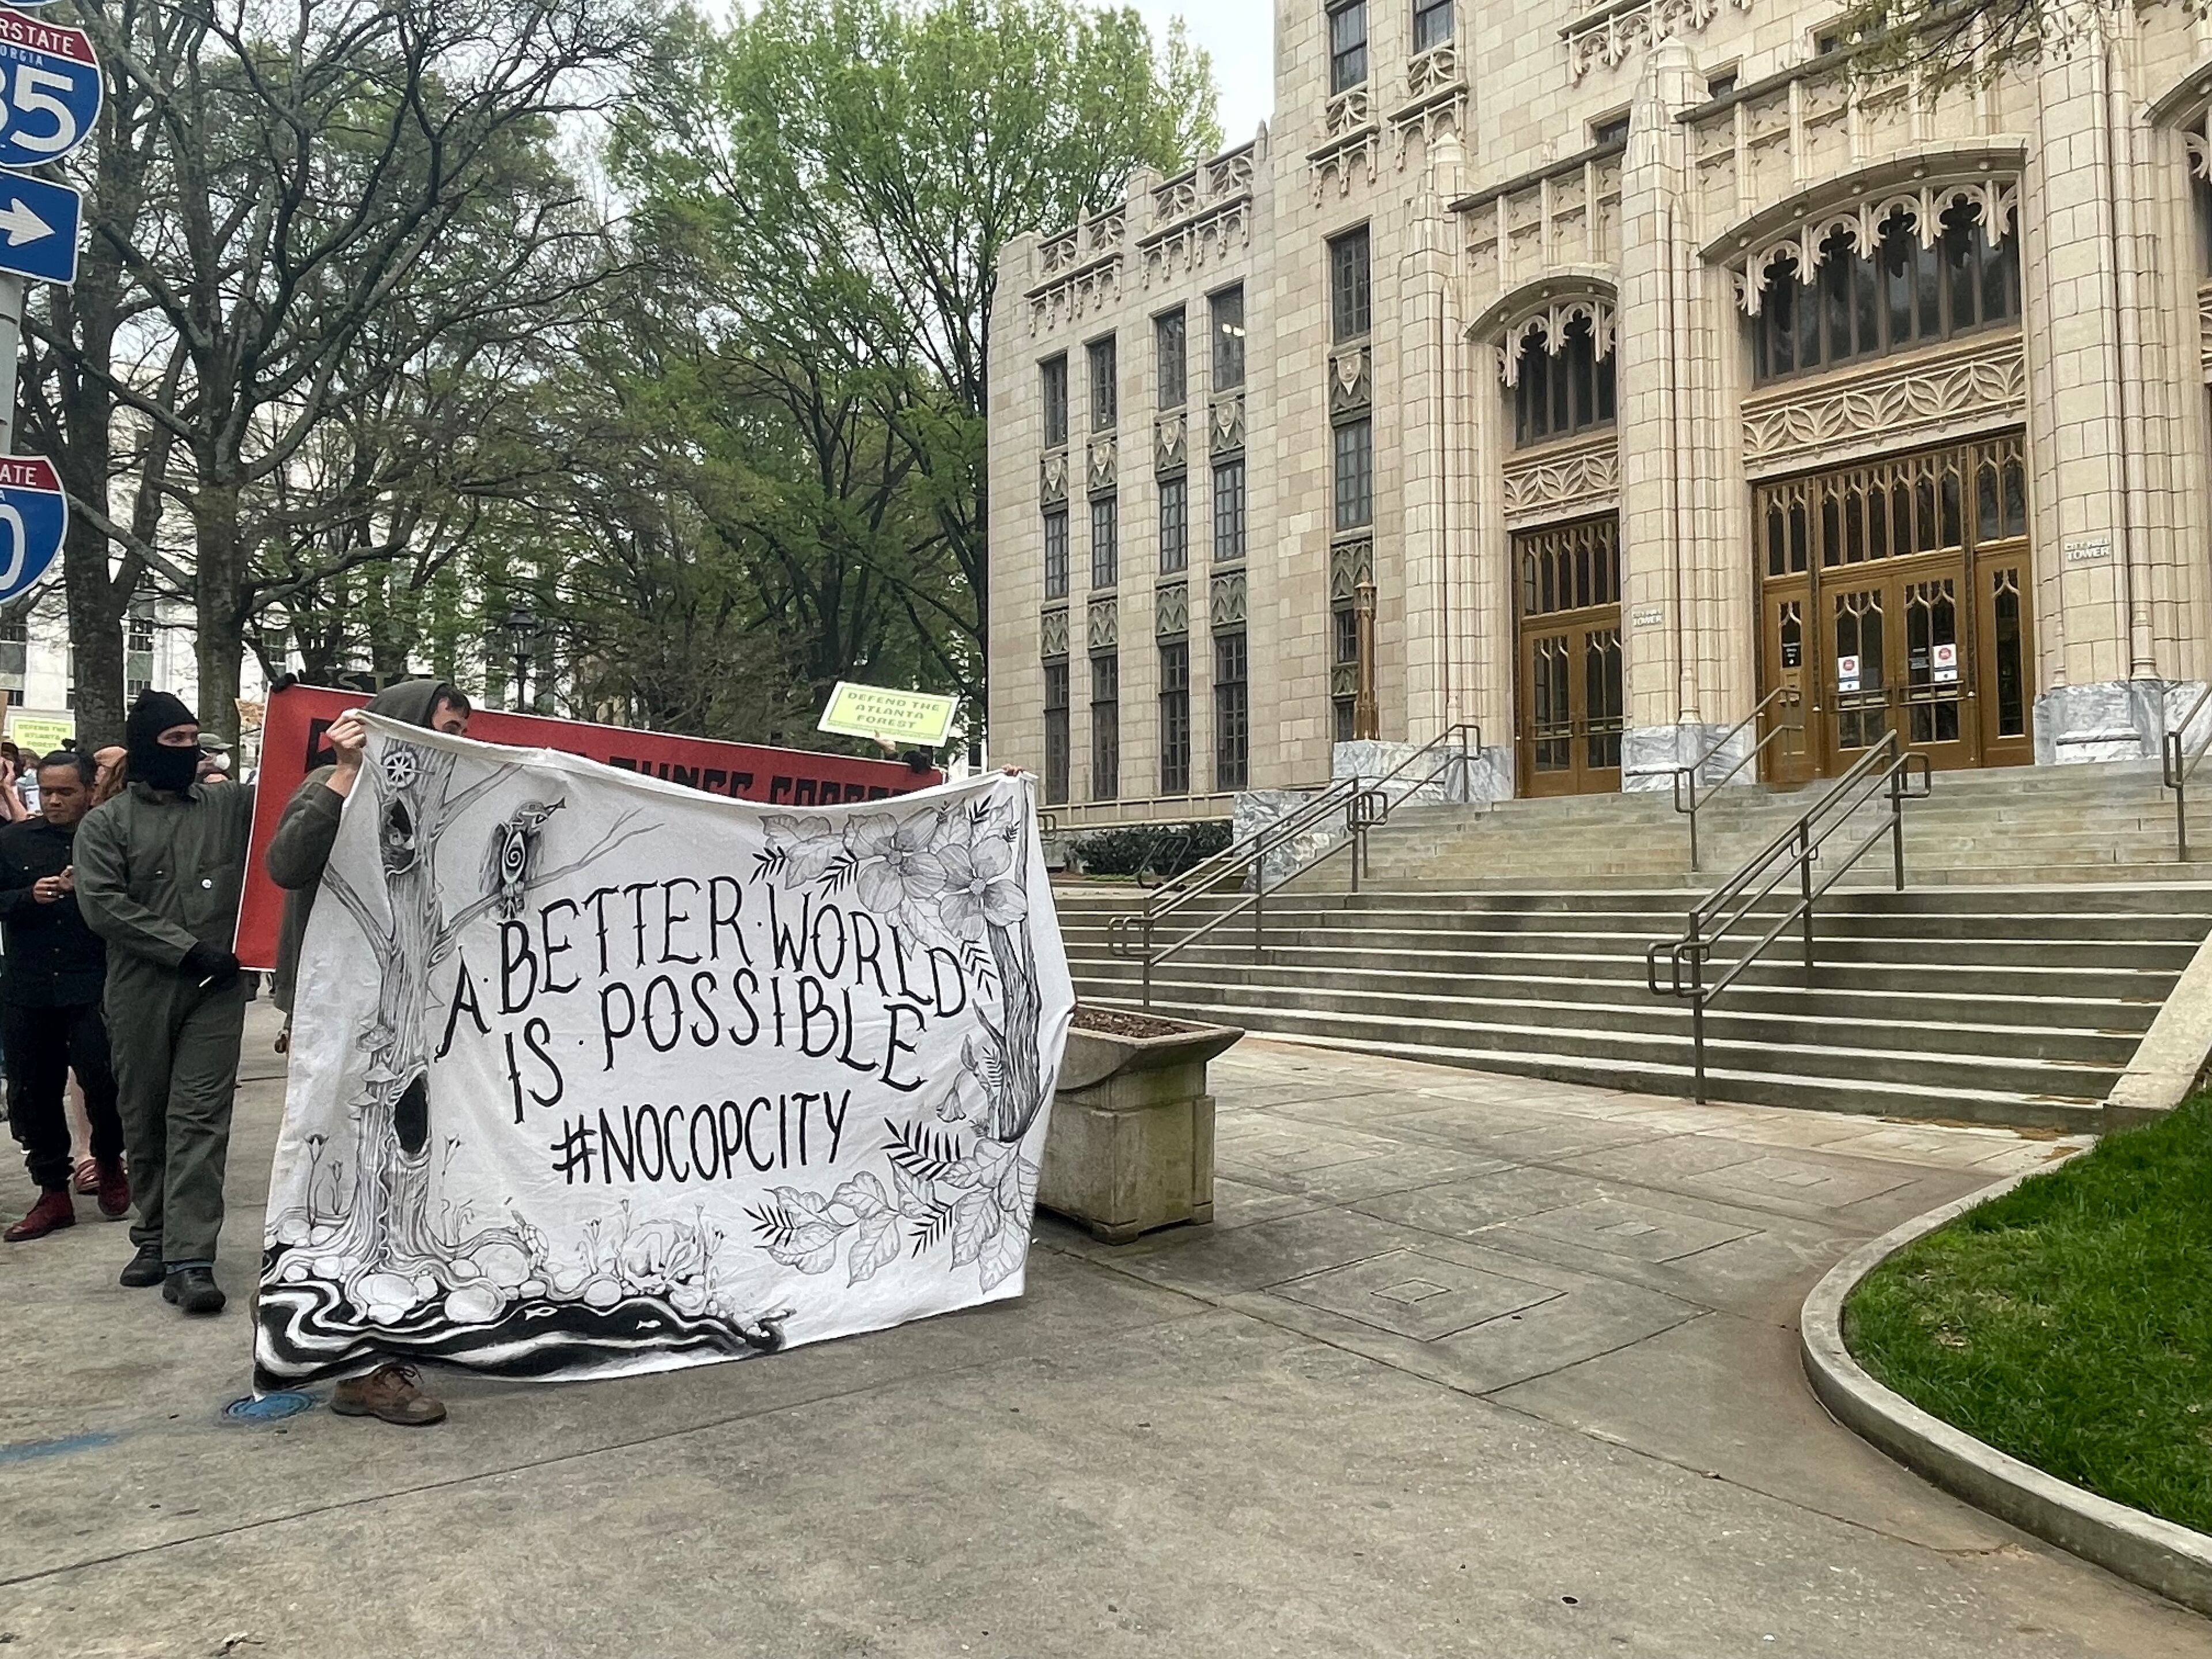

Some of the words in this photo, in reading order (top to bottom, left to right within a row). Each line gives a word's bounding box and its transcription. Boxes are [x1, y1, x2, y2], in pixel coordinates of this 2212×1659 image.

[847, 692, 906, 707] DEFEND
[912, 701, 941, 711] THE
[855, 704, 924, 719] ATLANTA
[856, 714, 916, 729] FOREST
[497, 875, 753, 1015] BETTER
[766, 881, 967, 1018] WORLD
[503, 1017, 564, 1124] IS
[598, 968, 929, 1092] POSSIBLE
[550, 1089, 852, 1185] #NOCOPCITY
